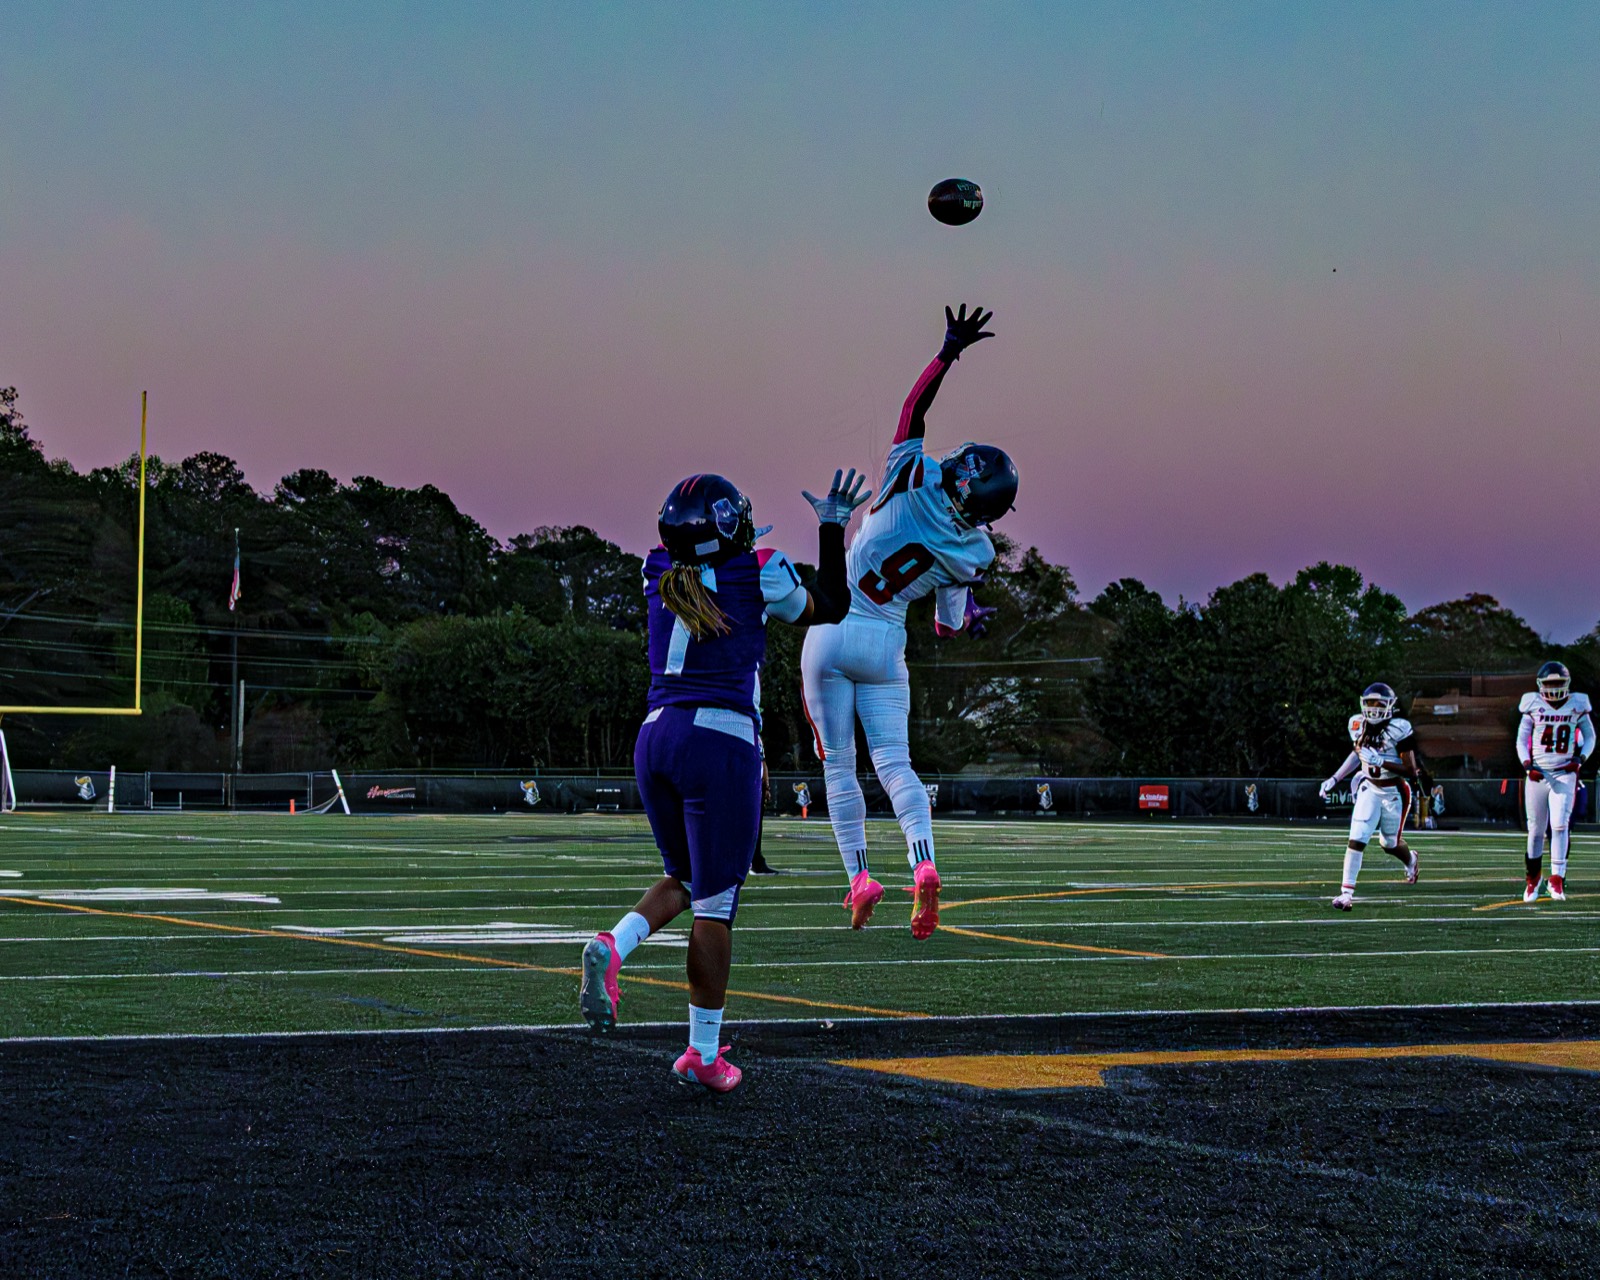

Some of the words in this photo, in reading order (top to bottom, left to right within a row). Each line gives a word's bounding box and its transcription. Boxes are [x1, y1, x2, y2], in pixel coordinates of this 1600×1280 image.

[779, 556, 801, 588] 7
[858, 543, 937, 606] 9
[1541, 724, 1571, 755] 48
